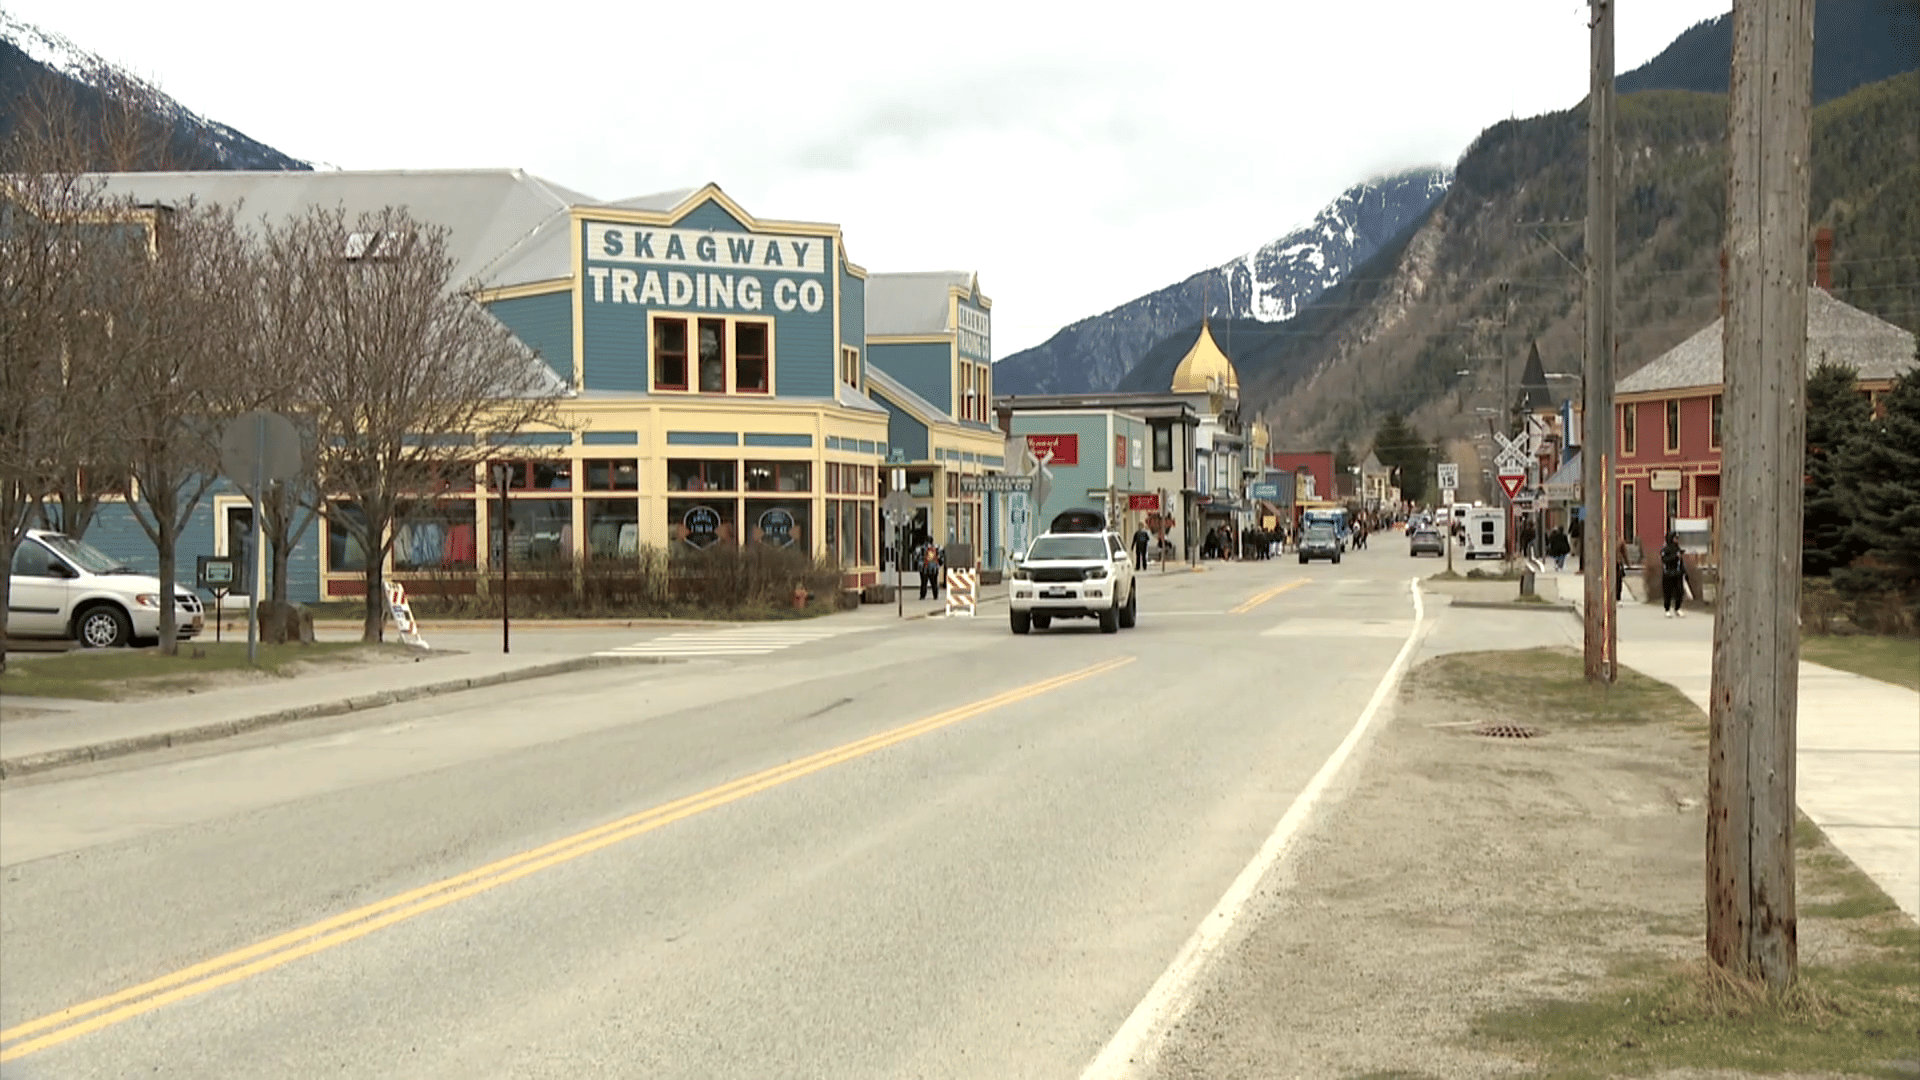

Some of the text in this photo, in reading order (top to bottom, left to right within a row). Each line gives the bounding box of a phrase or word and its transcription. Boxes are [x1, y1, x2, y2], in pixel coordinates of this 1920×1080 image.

[603, 230, 809, 267] SKAGWAY
[588, 267, 824, 312] TRADING CO
[1443, 476, 1455, 487] 15
